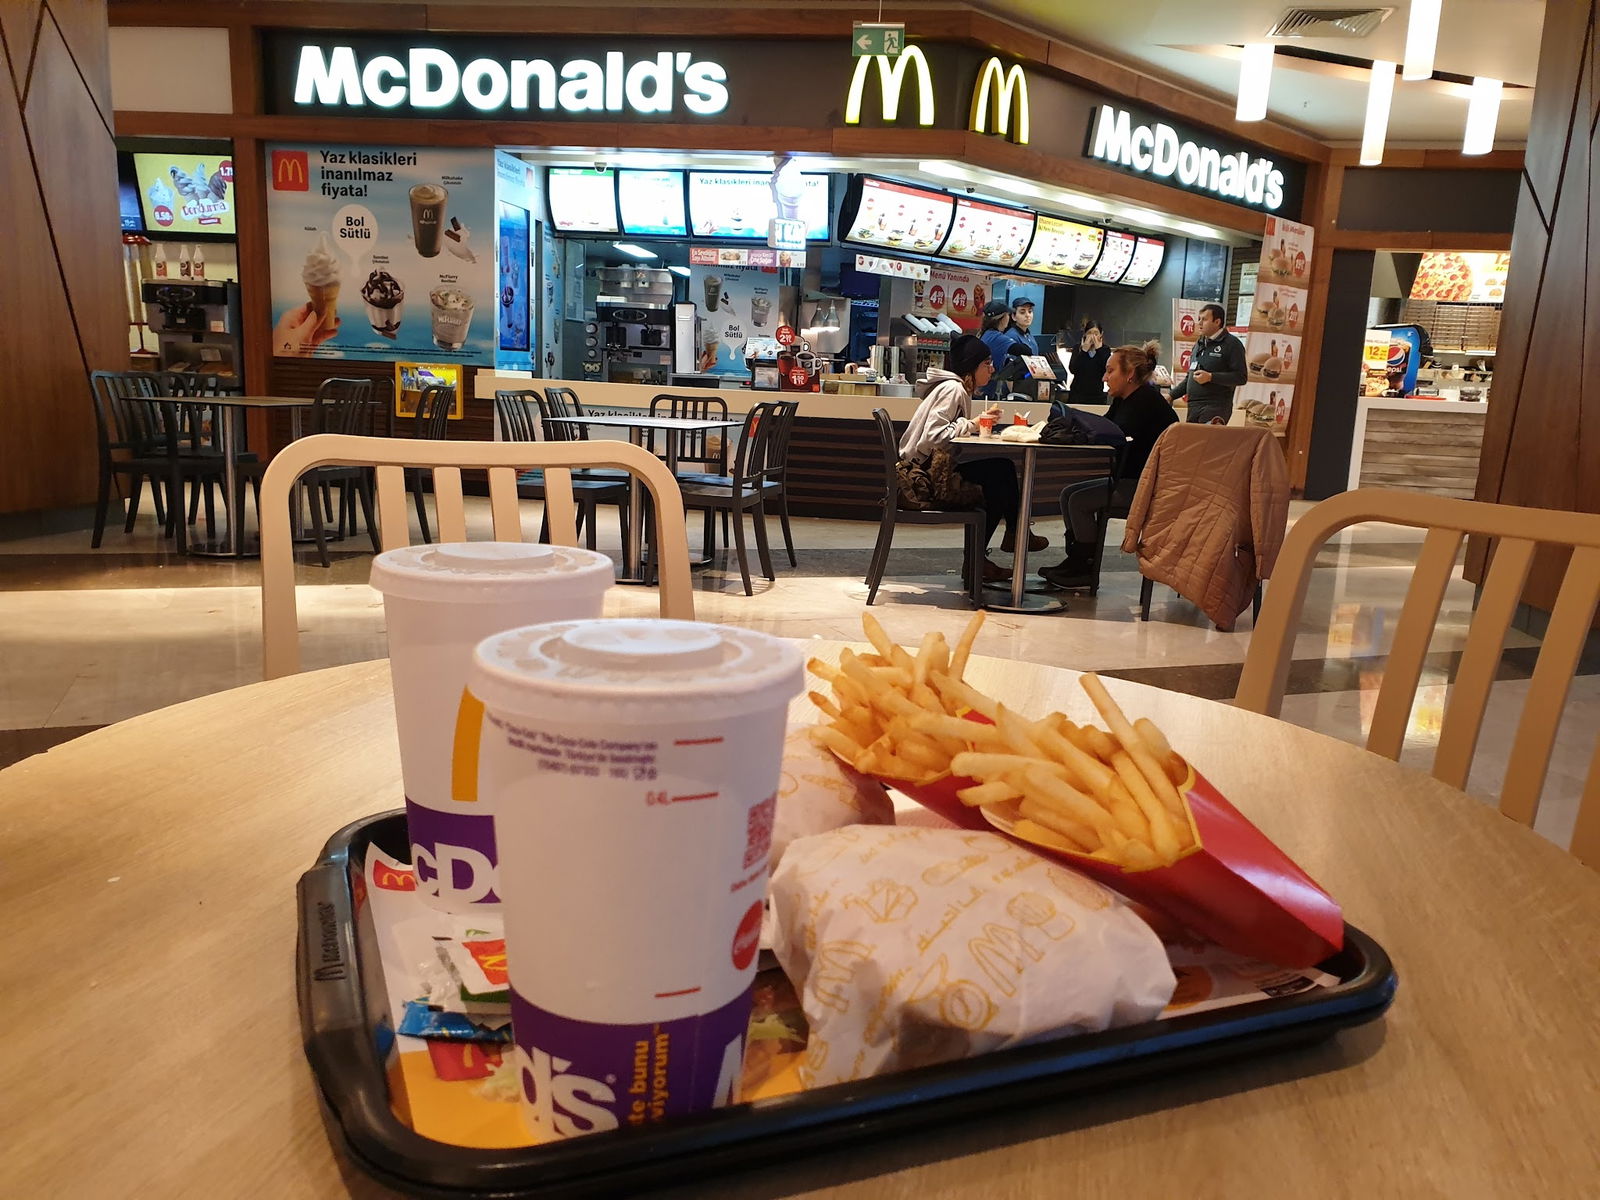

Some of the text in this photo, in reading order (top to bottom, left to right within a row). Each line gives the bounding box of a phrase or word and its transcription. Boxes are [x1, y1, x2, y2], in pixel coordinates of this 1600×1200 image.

[294, 44, 730, 116] McDonald's
[320, 150, 417, 167] Yaz klasikleri
[1090, 103, 1286, 210] McDonald's
[321, 166, 394, 182] inanılmaz
[321, 182, 368, 200] fiyata!
[346, 216, 365, 227] Bol
[340, 227, 371, 239] Sütlü
[725, 331, 743, 339] Sütlü
[1368, 346, 1380, 356] 12
[629, 1041, 649, 1094] bunu
